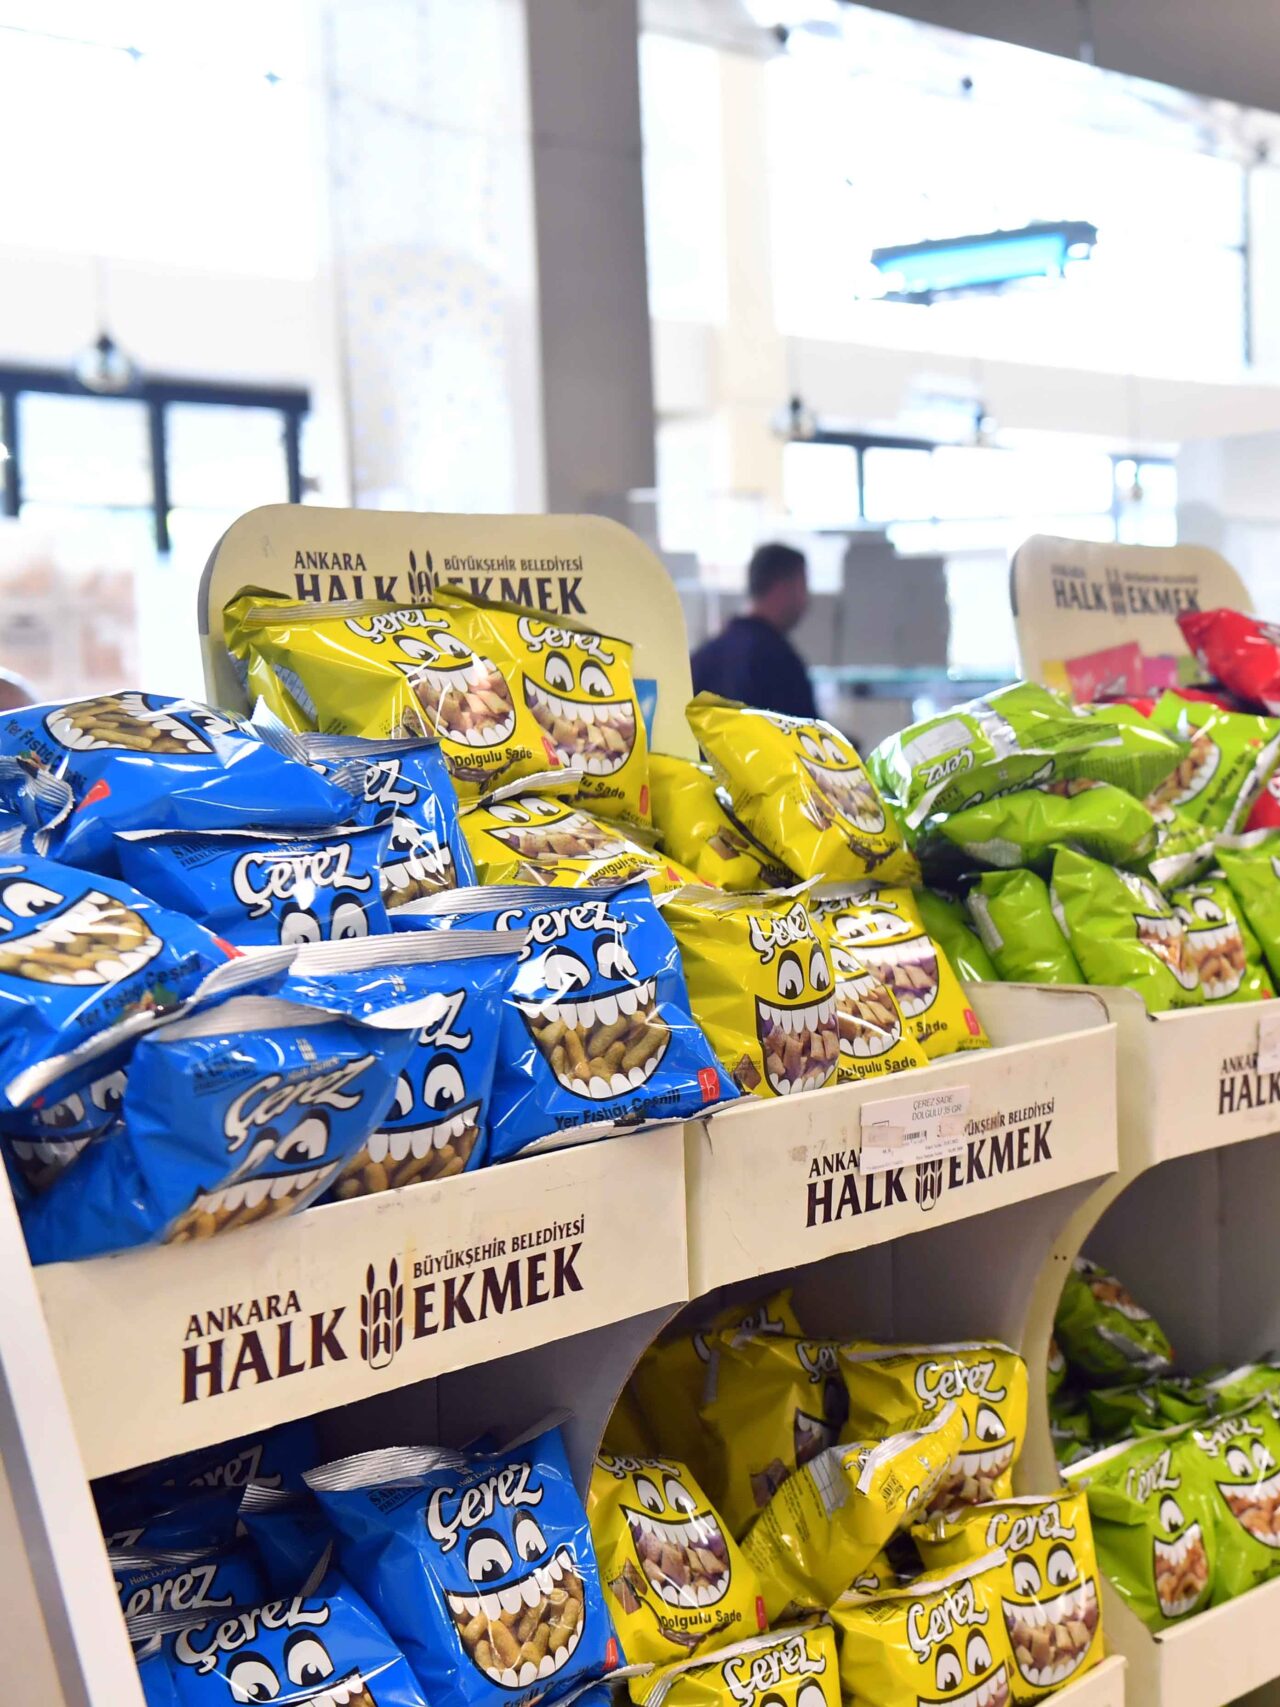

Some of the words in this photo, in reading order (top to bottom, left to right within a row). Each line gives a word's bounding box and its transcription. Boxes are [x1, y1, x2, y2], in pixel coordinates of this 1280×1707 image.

[294, 551, 367, 571] ANKARA
[443, 554, 516, 574] BÜYÜKŞEHİR
[520, 554, 584, 571] BELEDİYESİ
[294, 574, 399, 603] HALK
[447, 576, 588, 615] KMEK
[1052, 578, 1107, 612] HALK
[1125, 583, 1200, 615] EKMEK
[455, 750, 502, 769] Dolgulu
[505, 748, 533, 761] Sade
[596, 782, 626, 800] Sade
[233, 842, 372, 920] Çerez
[885, 1056, 917, 1071] Sade
[1008, 1097, 1055, 1124] BELEDİYESİ
[806, 1166, 908, 1228] HALK
[948, 1120, 1054, 1190] EKMEK
[809, 1149, 861, 1178] ANKA
[413, 1239, 506, 1279] BÜYÜKŞEHİR
[511, 1214, 586, 1252] BELEDİYESİ
[181, 1306, 348, 1405] HALK
[412, 1242, 585, 1341] EKMEK
[184, 1290, 303, 1341] ANKARA
[914, 1359, 1007, 1411] Çerez
[425, 1462, 544, 1552] Çerez
[115, 1563, 233, 1618] erez
[174, 1595, 331, 1675] Çerez
[660, 1613, 713, 1630] Dolgulu
[715, 1609, 742, 1624] Sade
[906, 1576, 990, 1665] Çerez
[721, 1635, 827, 1707] Çerez
